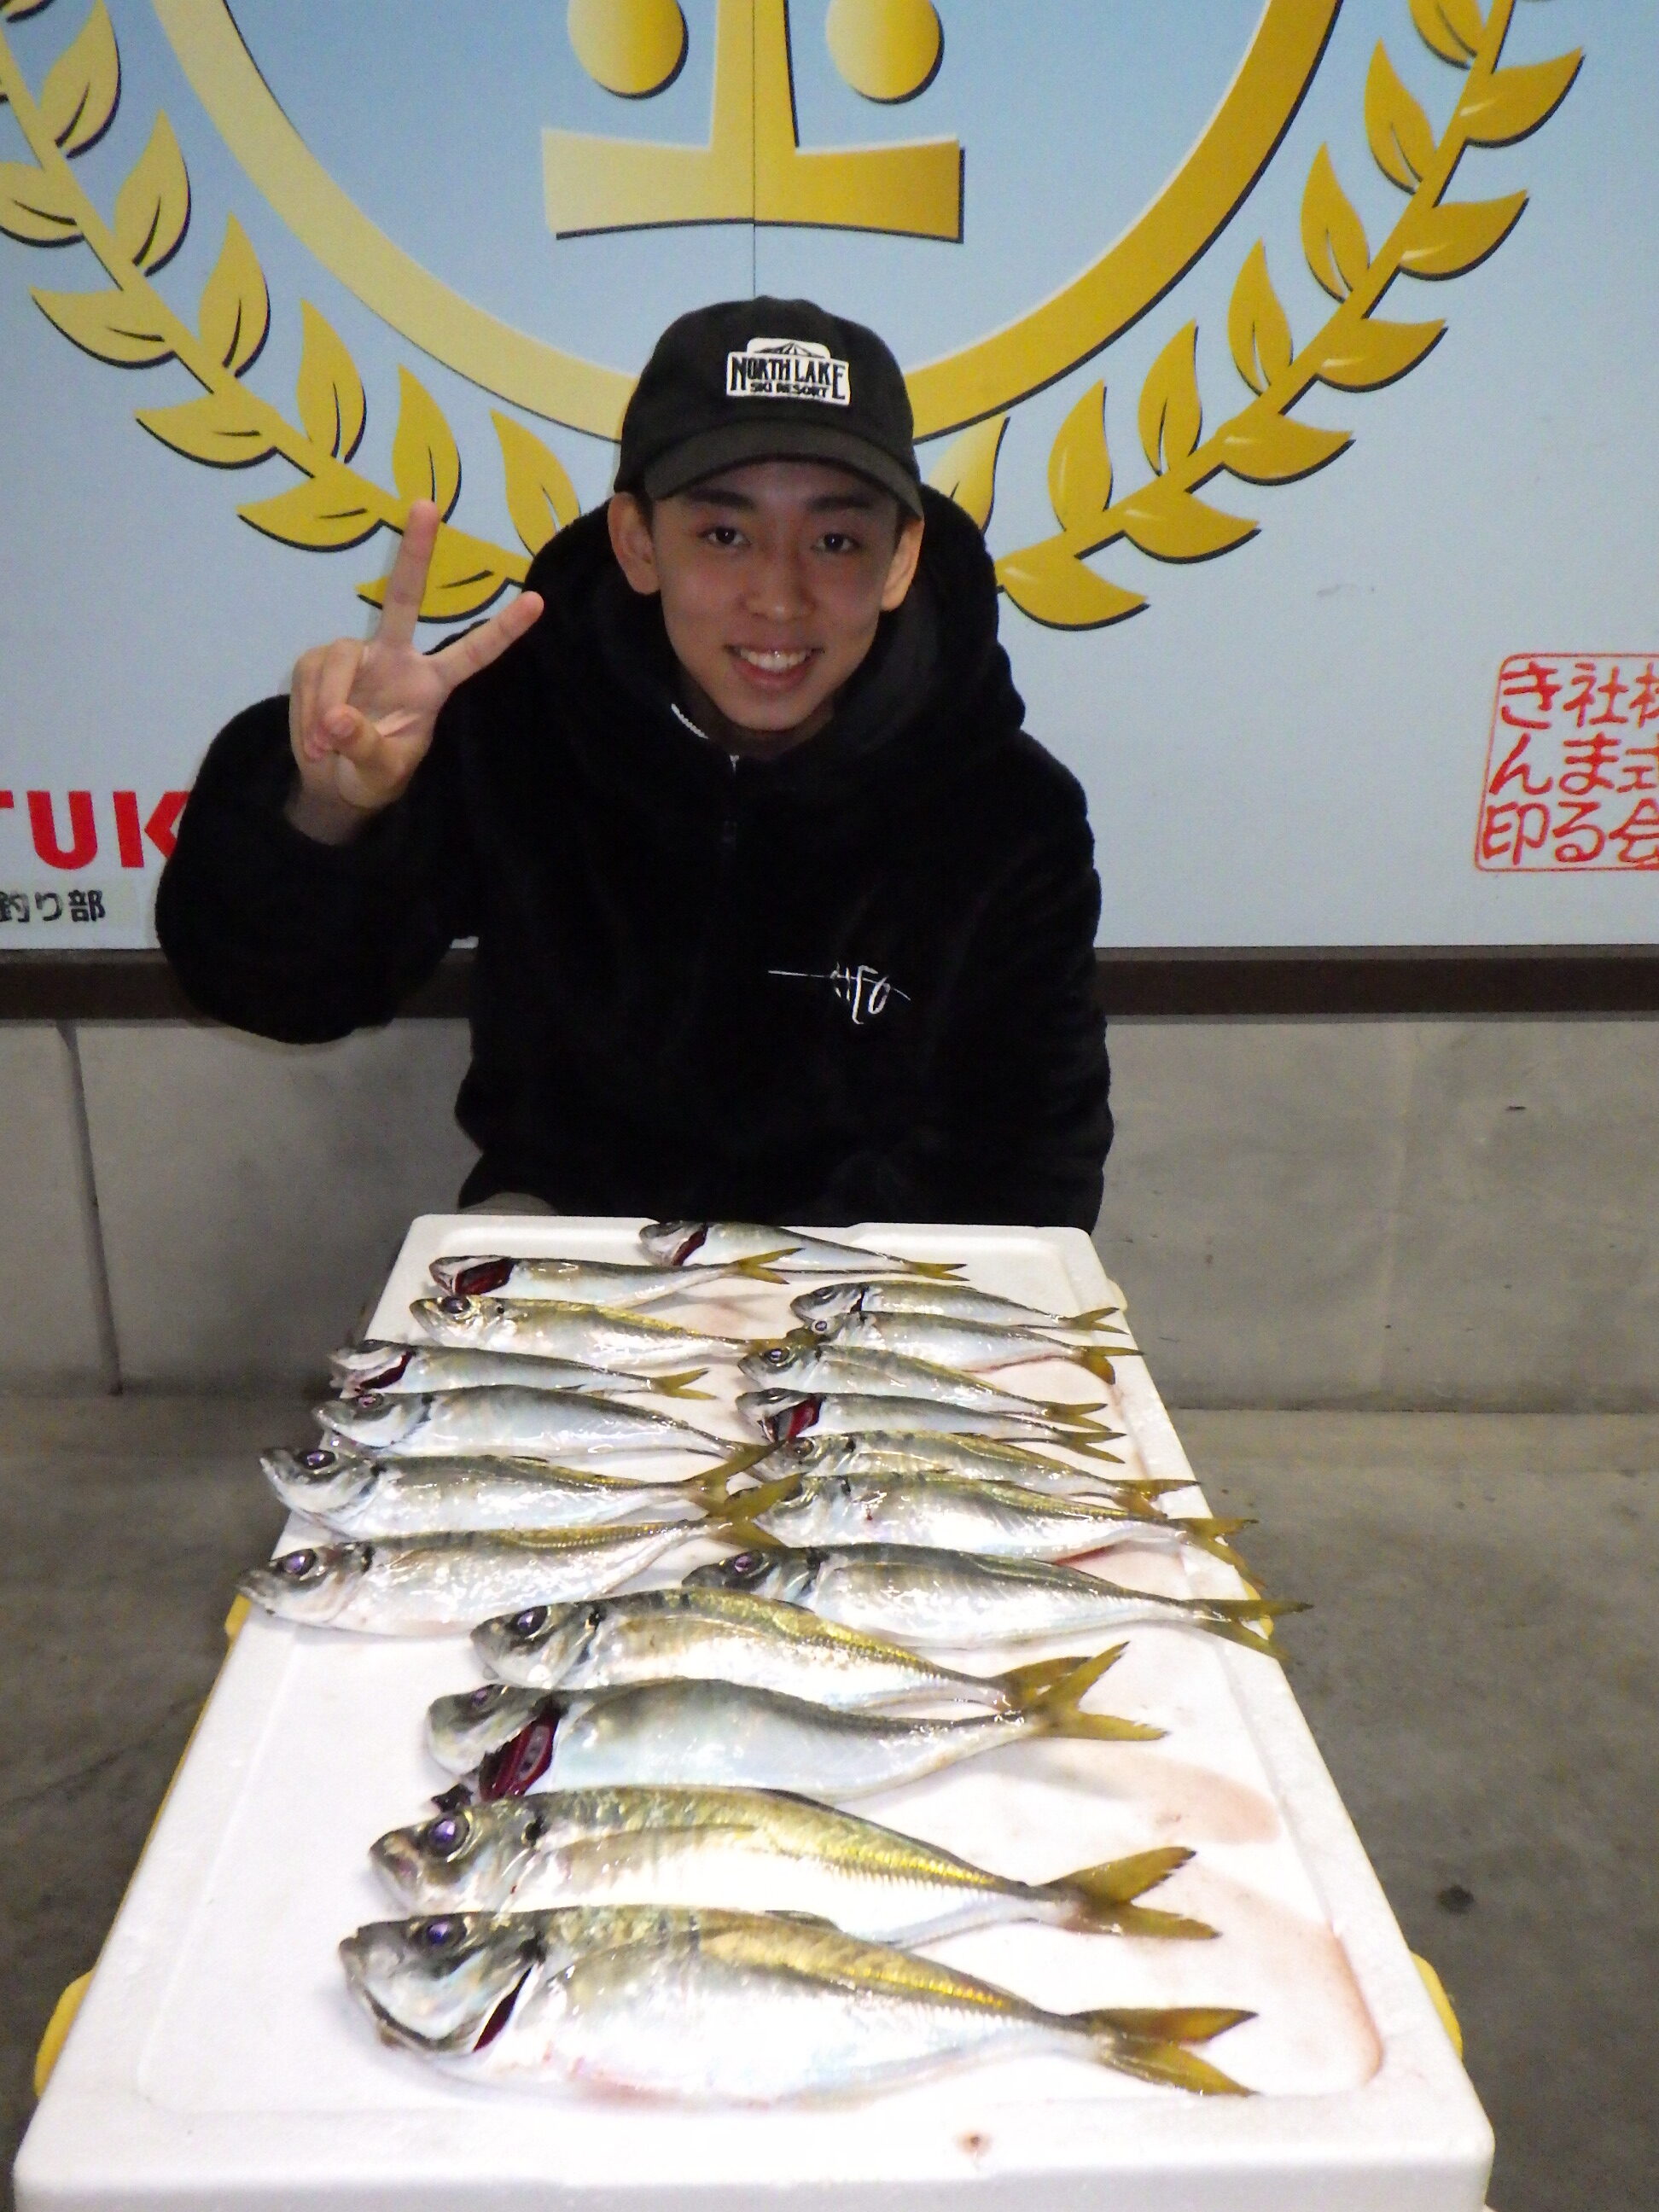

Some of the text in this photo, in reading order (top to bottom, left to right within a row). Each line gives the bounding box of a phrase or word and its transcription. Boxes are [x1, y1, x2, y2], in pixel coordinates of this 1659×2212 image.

[731, 357, 846, 400] NORTH LAKE
[0, 790, 191, 870] UK
